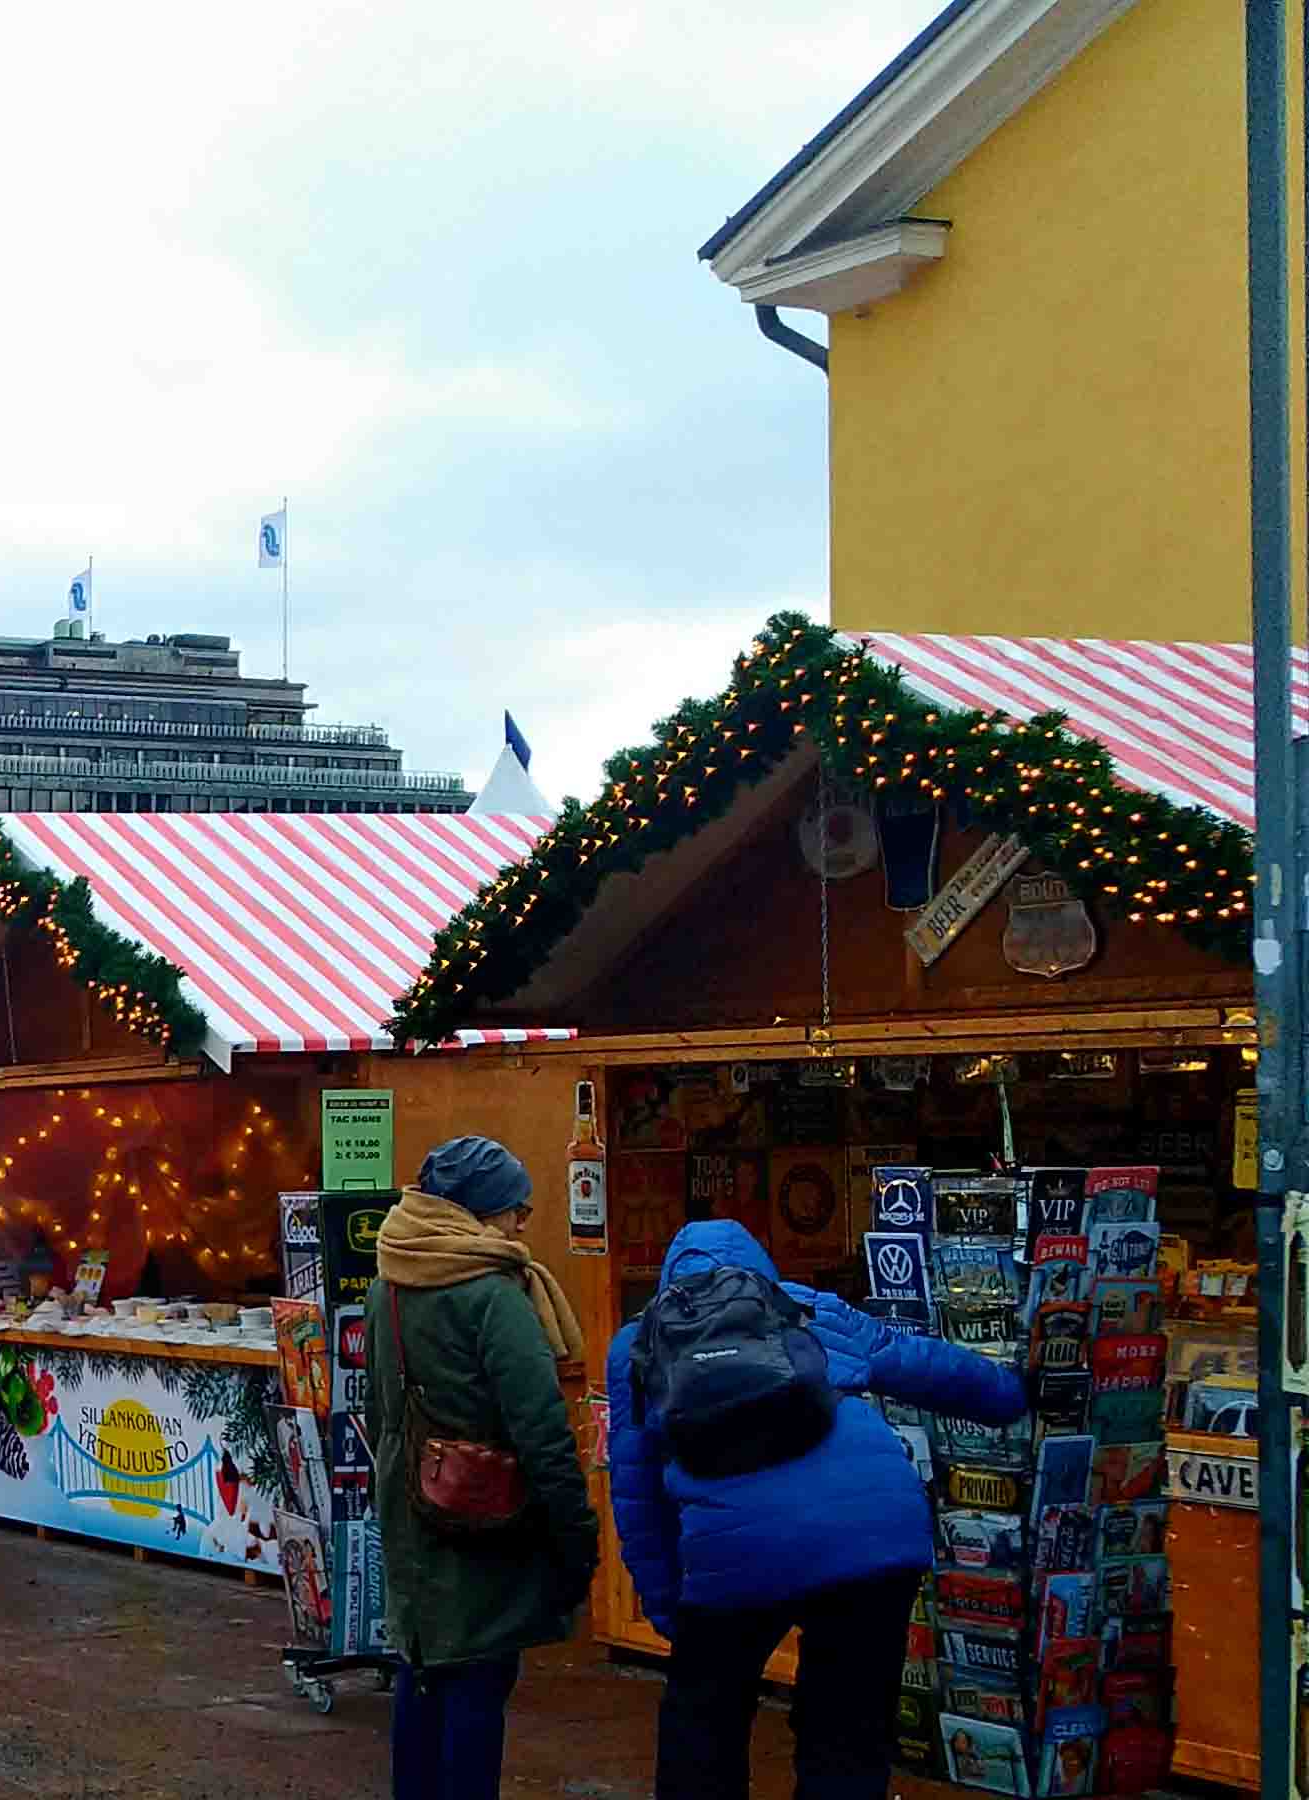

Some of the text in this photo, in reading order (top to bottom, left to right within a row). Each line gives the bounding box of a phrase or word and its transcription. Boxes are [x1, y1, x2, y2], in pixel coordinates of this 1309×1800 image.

[1038, 1200, 1077, 1221] VIP
[81, 1406, 182, 1437] SILLANKORVAN
[78, 1422, 189, 1473] YRTTIJUUSTO
